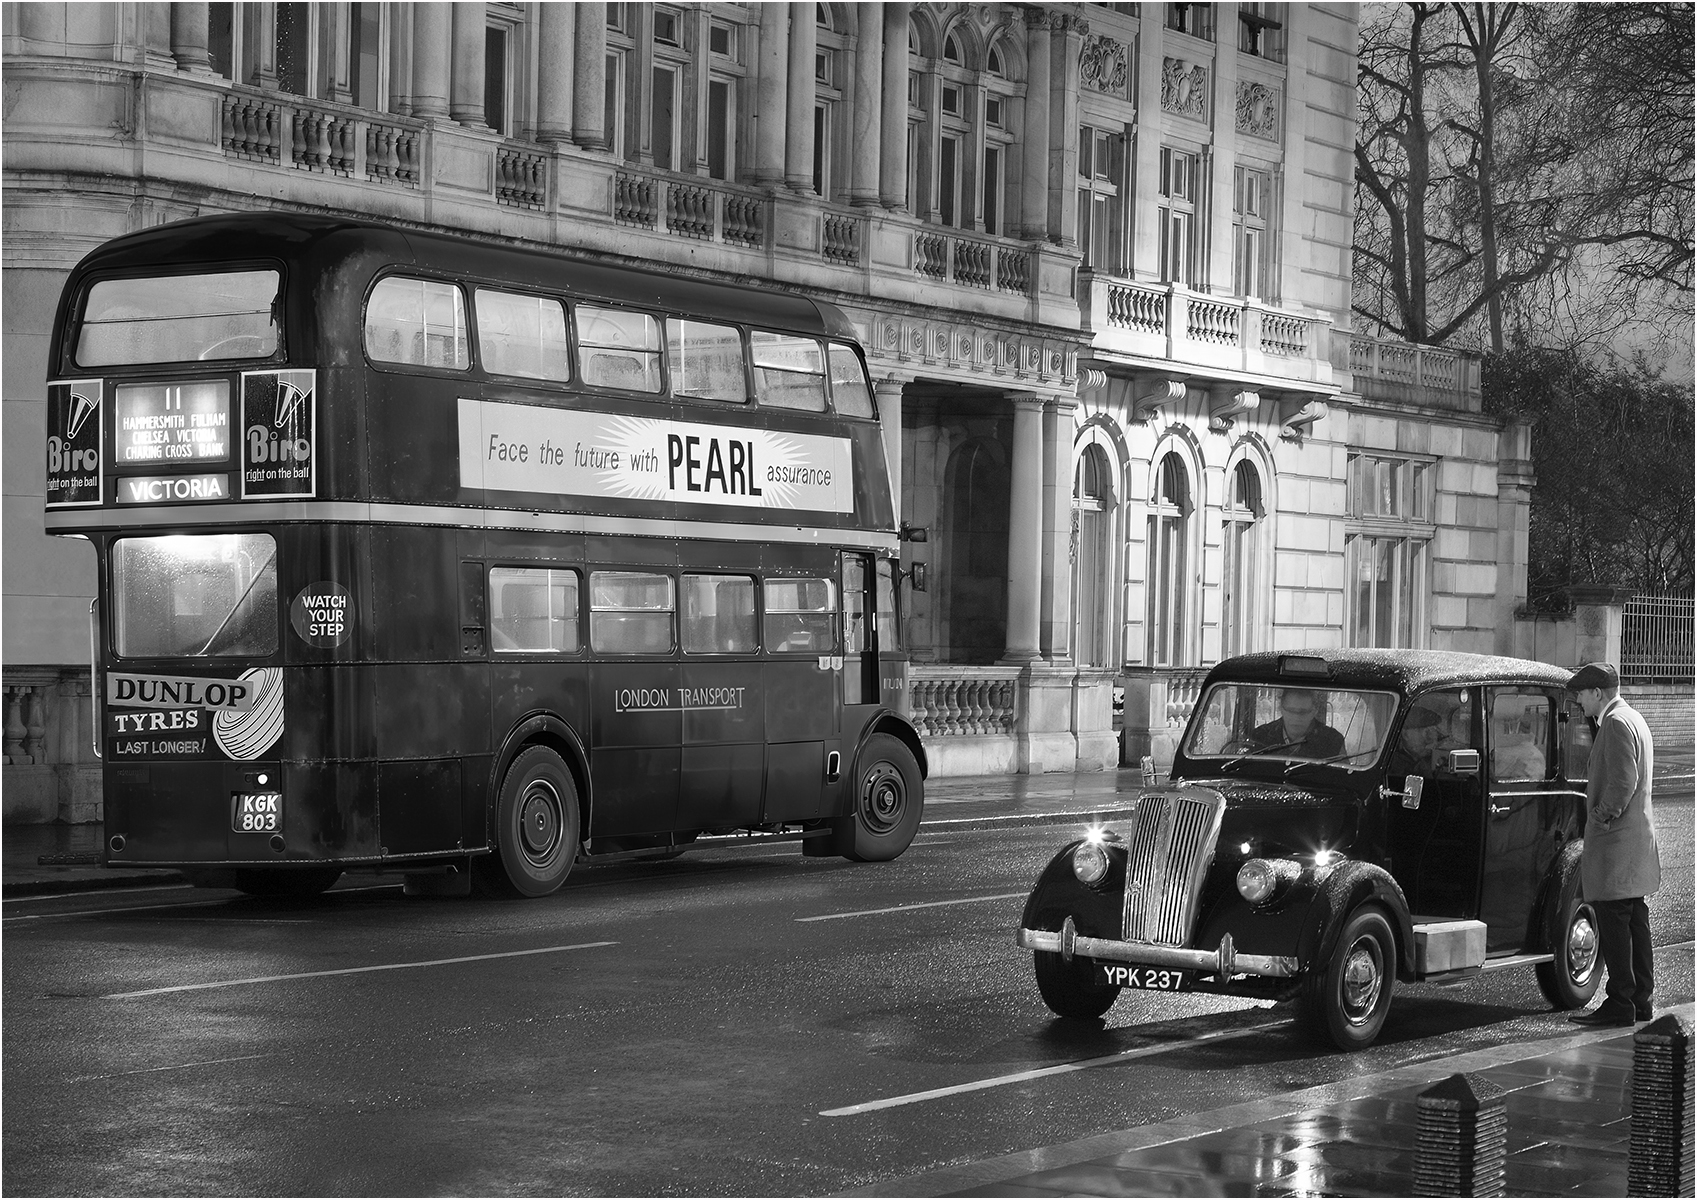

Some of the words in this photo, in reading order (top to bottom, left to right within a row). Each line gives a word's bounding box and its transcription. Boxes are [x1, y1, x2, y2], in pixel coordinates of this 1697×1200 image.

[165, 386, 181, 410] 11
[123, 414, 185, 430] HAMMERSMITH
[190, 412, 226, 427] FULHAM
[132, 430, 170, 445] CHELSEA
[176, 428, 217, 443] VICTORIA
[246, 424, 311, 464] Biro
[47, 435, 98, 473] Biro
[165, 443, 192, 458] CROSS
[198, 442, 224, 457] BANK
[246, 468, 265, 482] right
[265, 469, 277, 479] on
[277, 466, 292, 479] the
[293, 466, 309, 479] ball
[488, 433, 529, 464] Face
[539, 438, 565, 466] the
[574, 441, 620, 471] future
[630, 447, 659, 474] with
[667, 433, 762, 497] PEARL
[766, 463, 832, 488] assurance
[60, 479, 70, 488] on
[70, 476, 84, 488] the
[83, 475, 98, 487] ball
[129, 477, 222, 500] VICTORIA
[302, 594, 347, 609] WATCH
[308, 609, 344, 623] YOUR
[309, 623, 344, 637] STEP
[115, 678, 247, 708] DUNLOP
[615, 687, 670, 712] LONDON
[677, 686, 745, 709] TRANSPORT
[115, 709, 199, 733] TYRES
[116, 740, 149, 754] LAST
[152, 737, 207, 754] LONGER!
[243, 794, 279, 813] KGK
[242, 813, 276, 831] 803
[1104, 965, 1141, 987] YPK
[1145, 969, 1183, 990] 237
